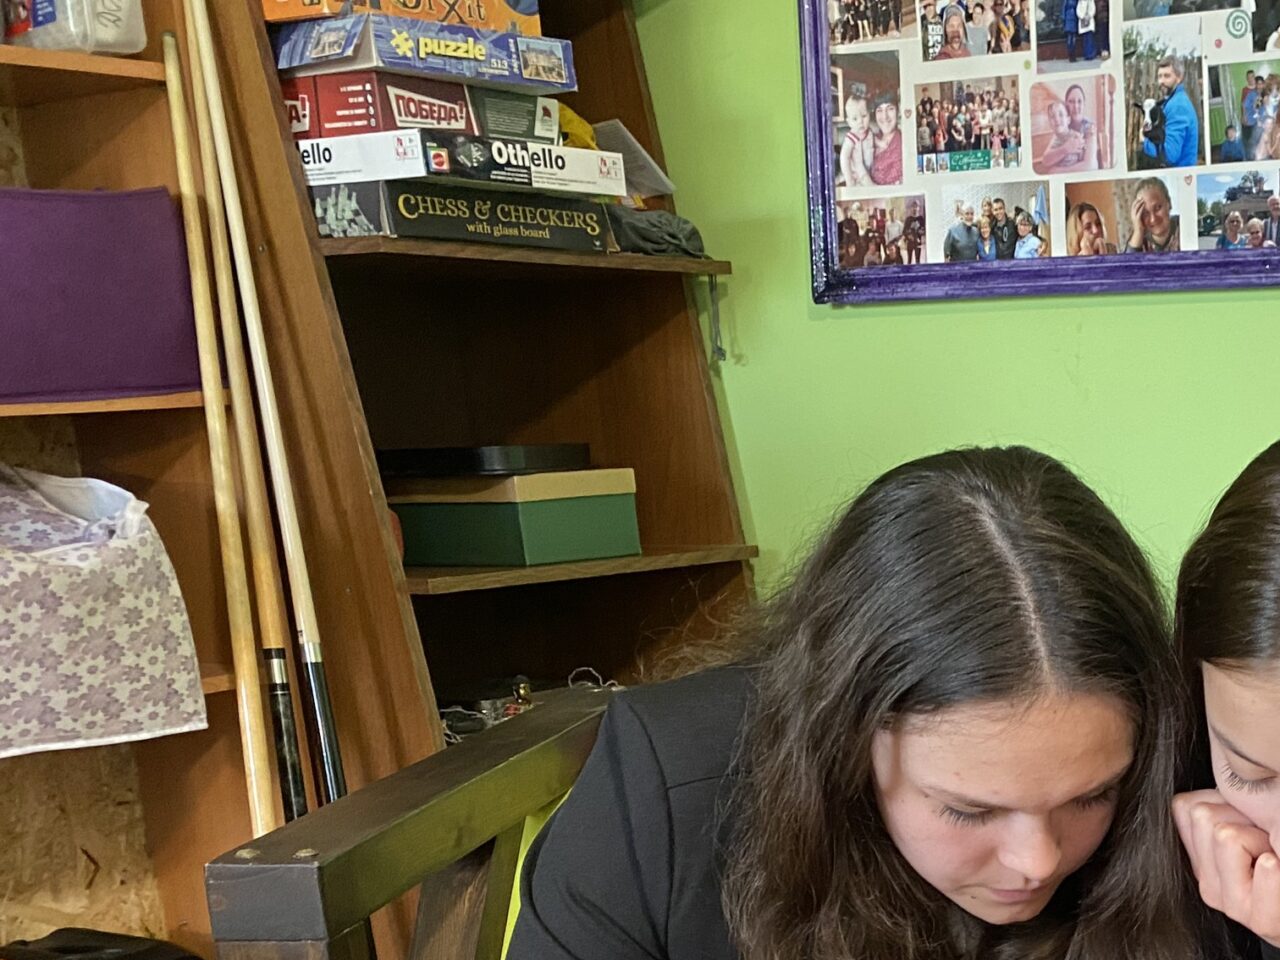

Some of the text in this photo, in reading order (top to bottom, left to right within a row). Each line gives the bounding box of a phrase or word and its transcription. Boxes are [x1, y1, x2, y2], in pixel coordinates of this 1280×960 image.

[418, 37, 487, 61] puzzle
[394, 94, 466, 126] ПОБЕДА!
[491, 141, 566, 171] Othello
[398, 193, 601, 236] CHESS & CHECKERS
[467, 222, 550, 239] with glass board
